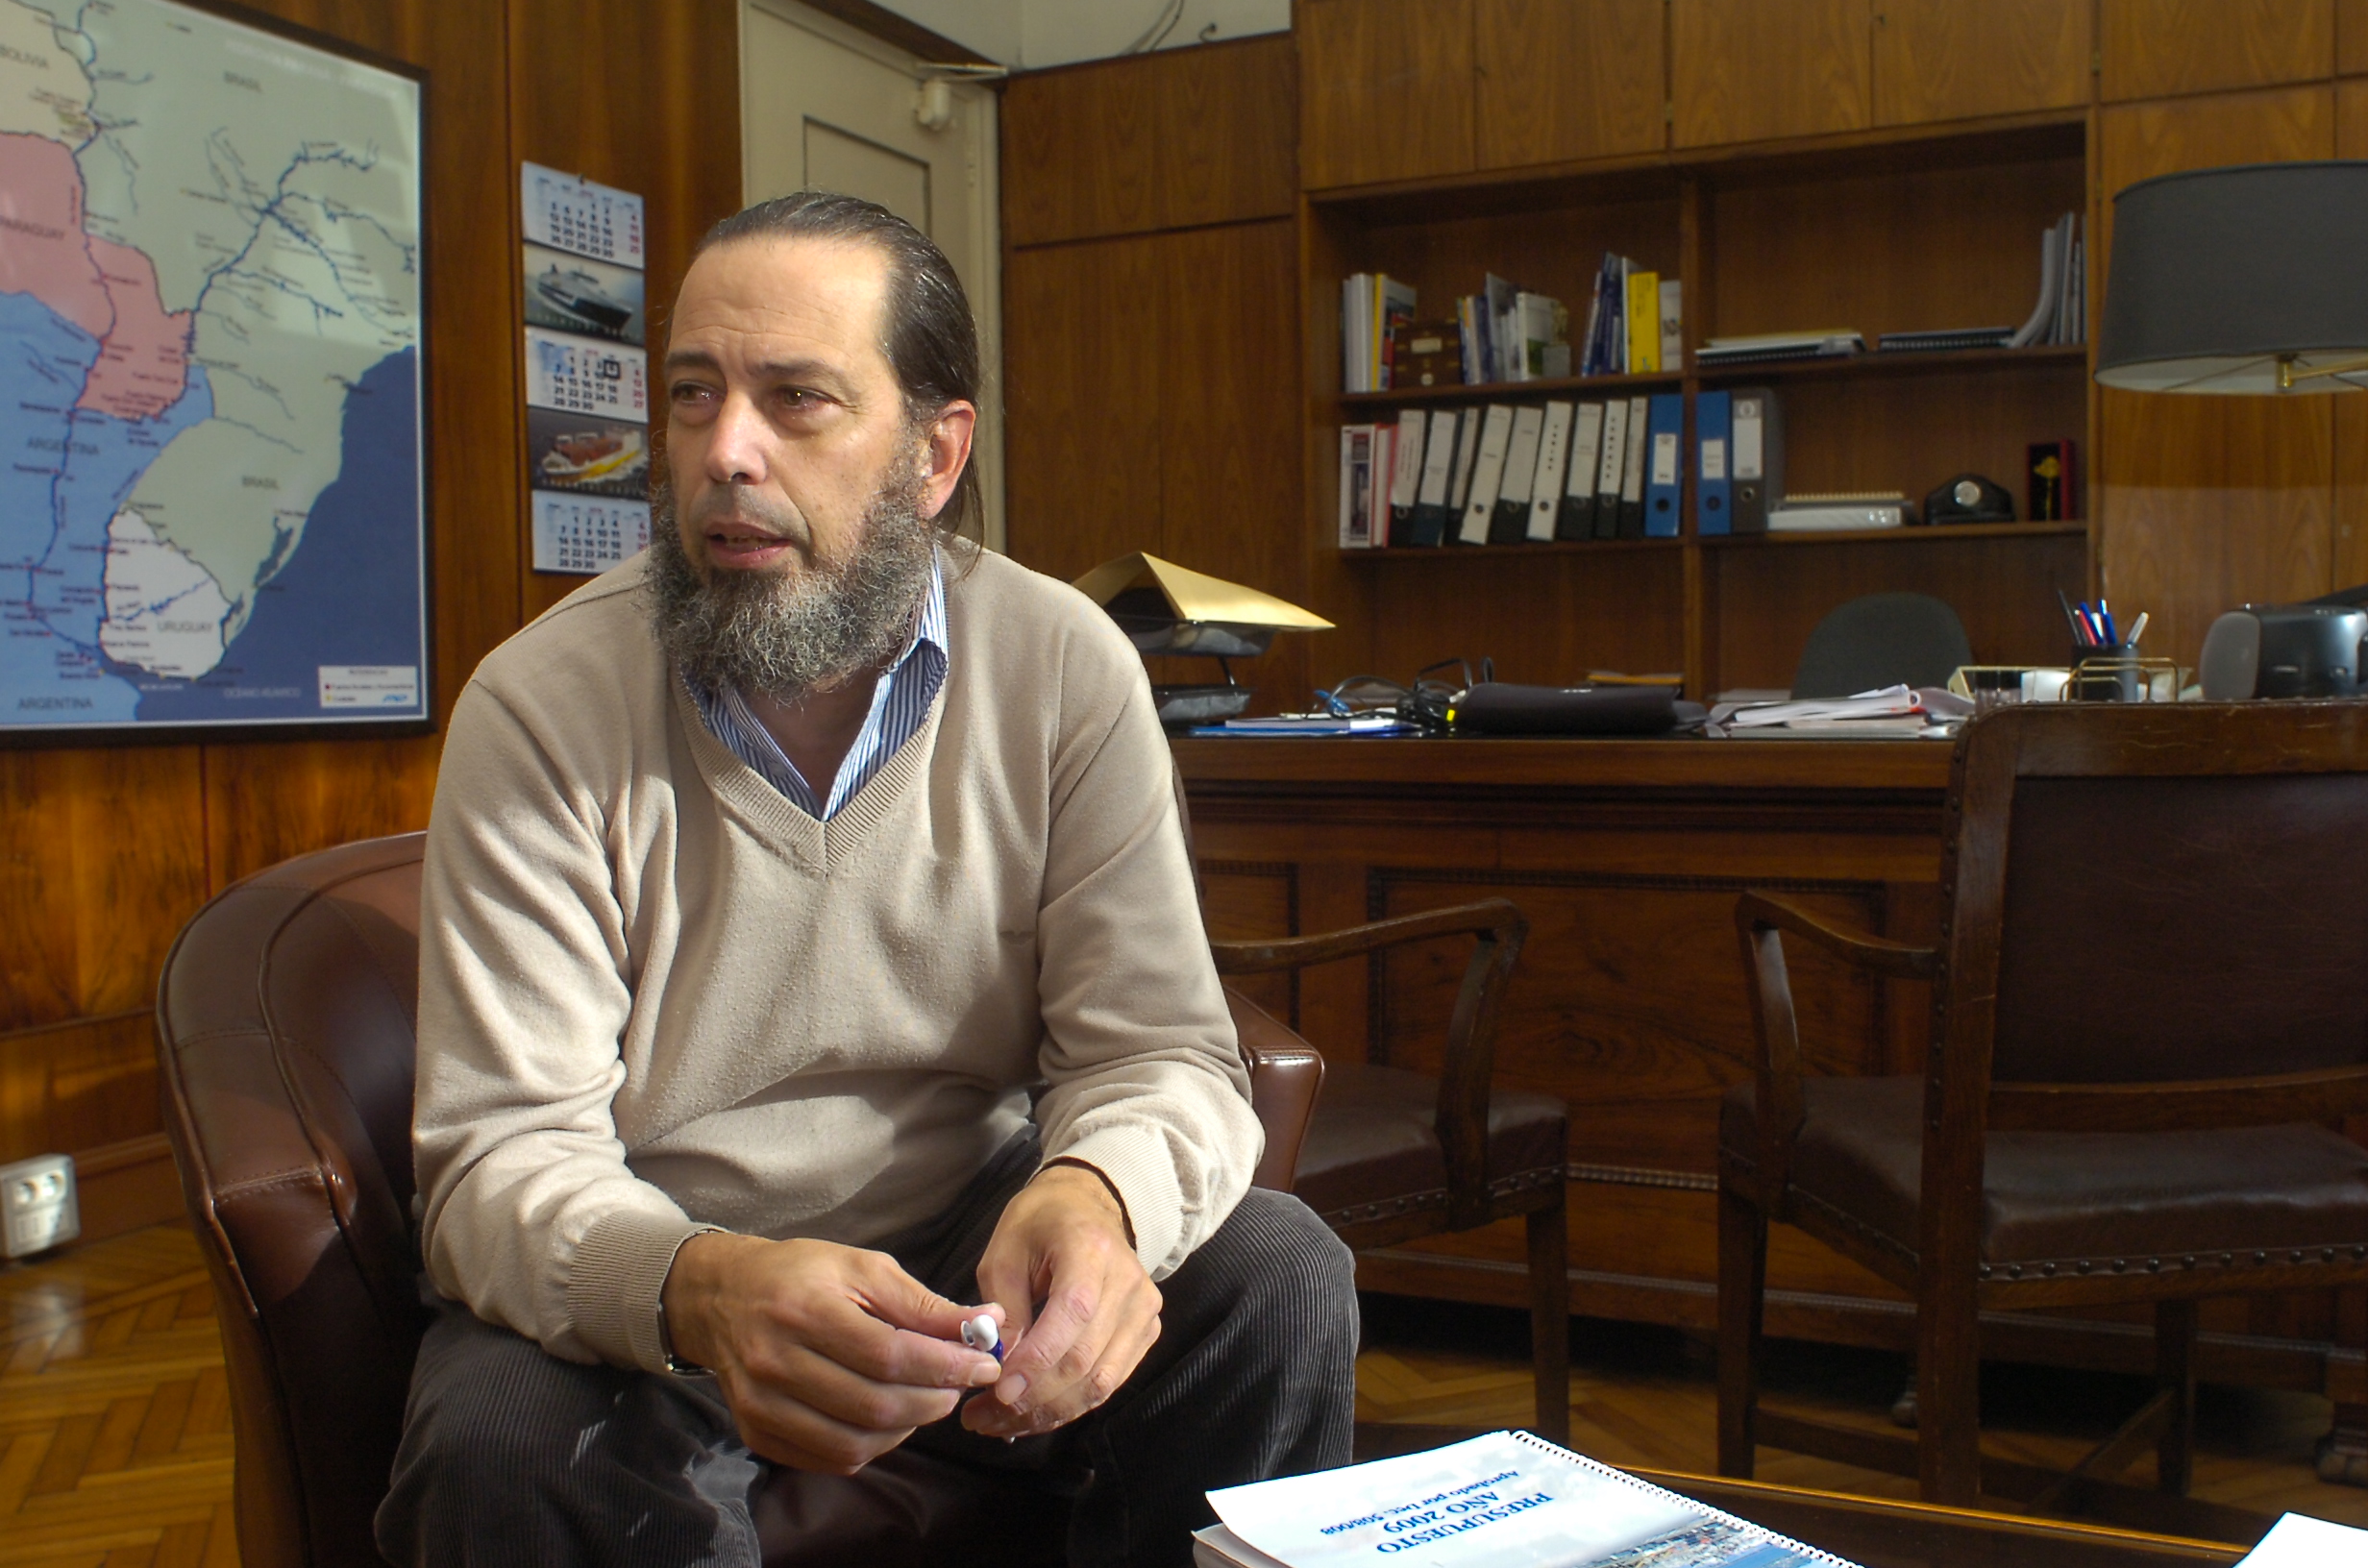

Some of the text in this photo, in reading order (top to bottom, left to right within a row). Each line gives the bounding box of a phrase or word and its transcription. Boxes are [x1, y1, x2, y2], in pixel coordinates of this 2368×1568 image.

[17, 696, 93, 711] ARGENTINA
[1449, 1470, 1519, 1496] Aprobado
[1384, 1503, 1421, 1515] Dec.
[1421, 1493, 1448, 1506] por
[1383, 1491, 1499, 1533] AÑO 2009
[1376, 1492, 1554, 1554] PRESUPUESTO
